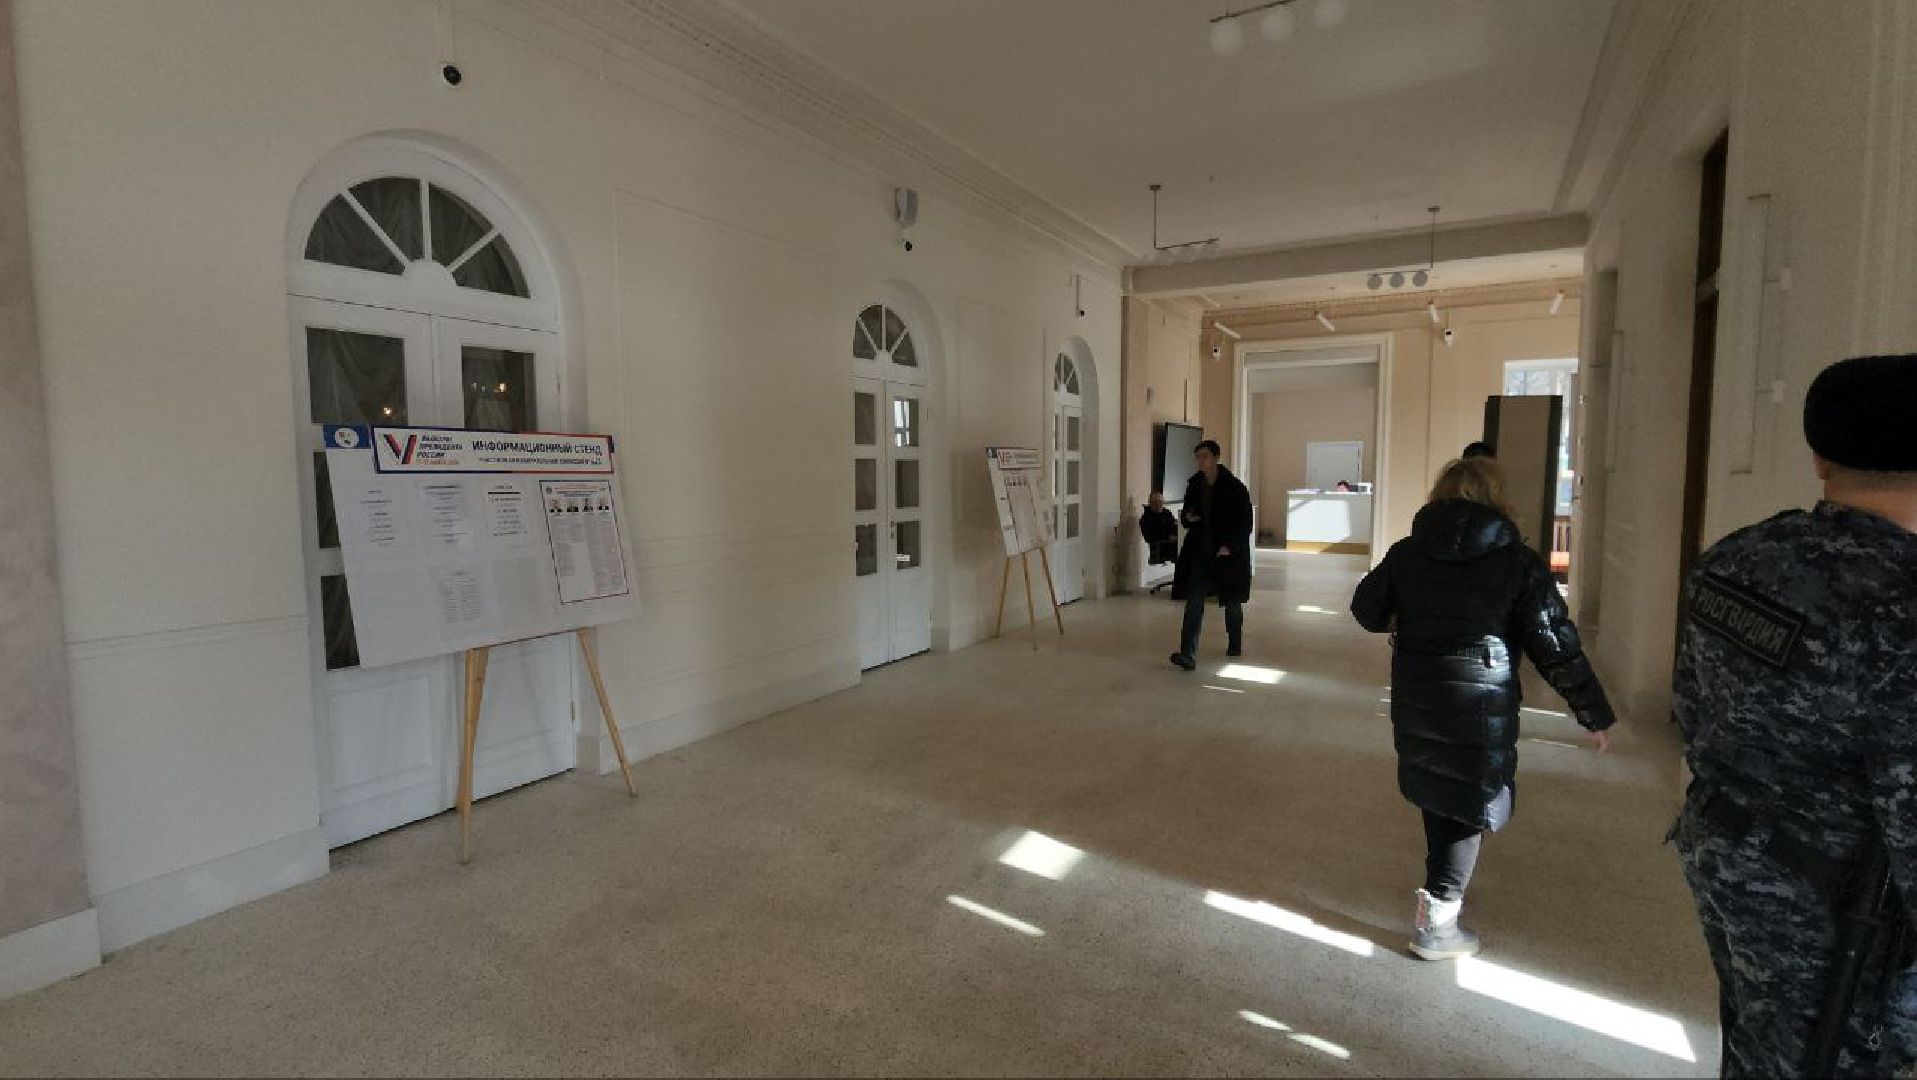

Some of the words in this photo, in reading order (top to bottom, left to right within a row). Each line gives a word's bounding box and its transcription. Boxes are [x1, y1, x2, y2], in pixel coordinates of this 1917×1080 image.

[472, 440, 572, 454] ИНФОРМАЦИОННЫЙ
[574, 444, 603, 457] СТЕНД
[1696, 586, 1789, 655] РОСГВАРДИЯ
